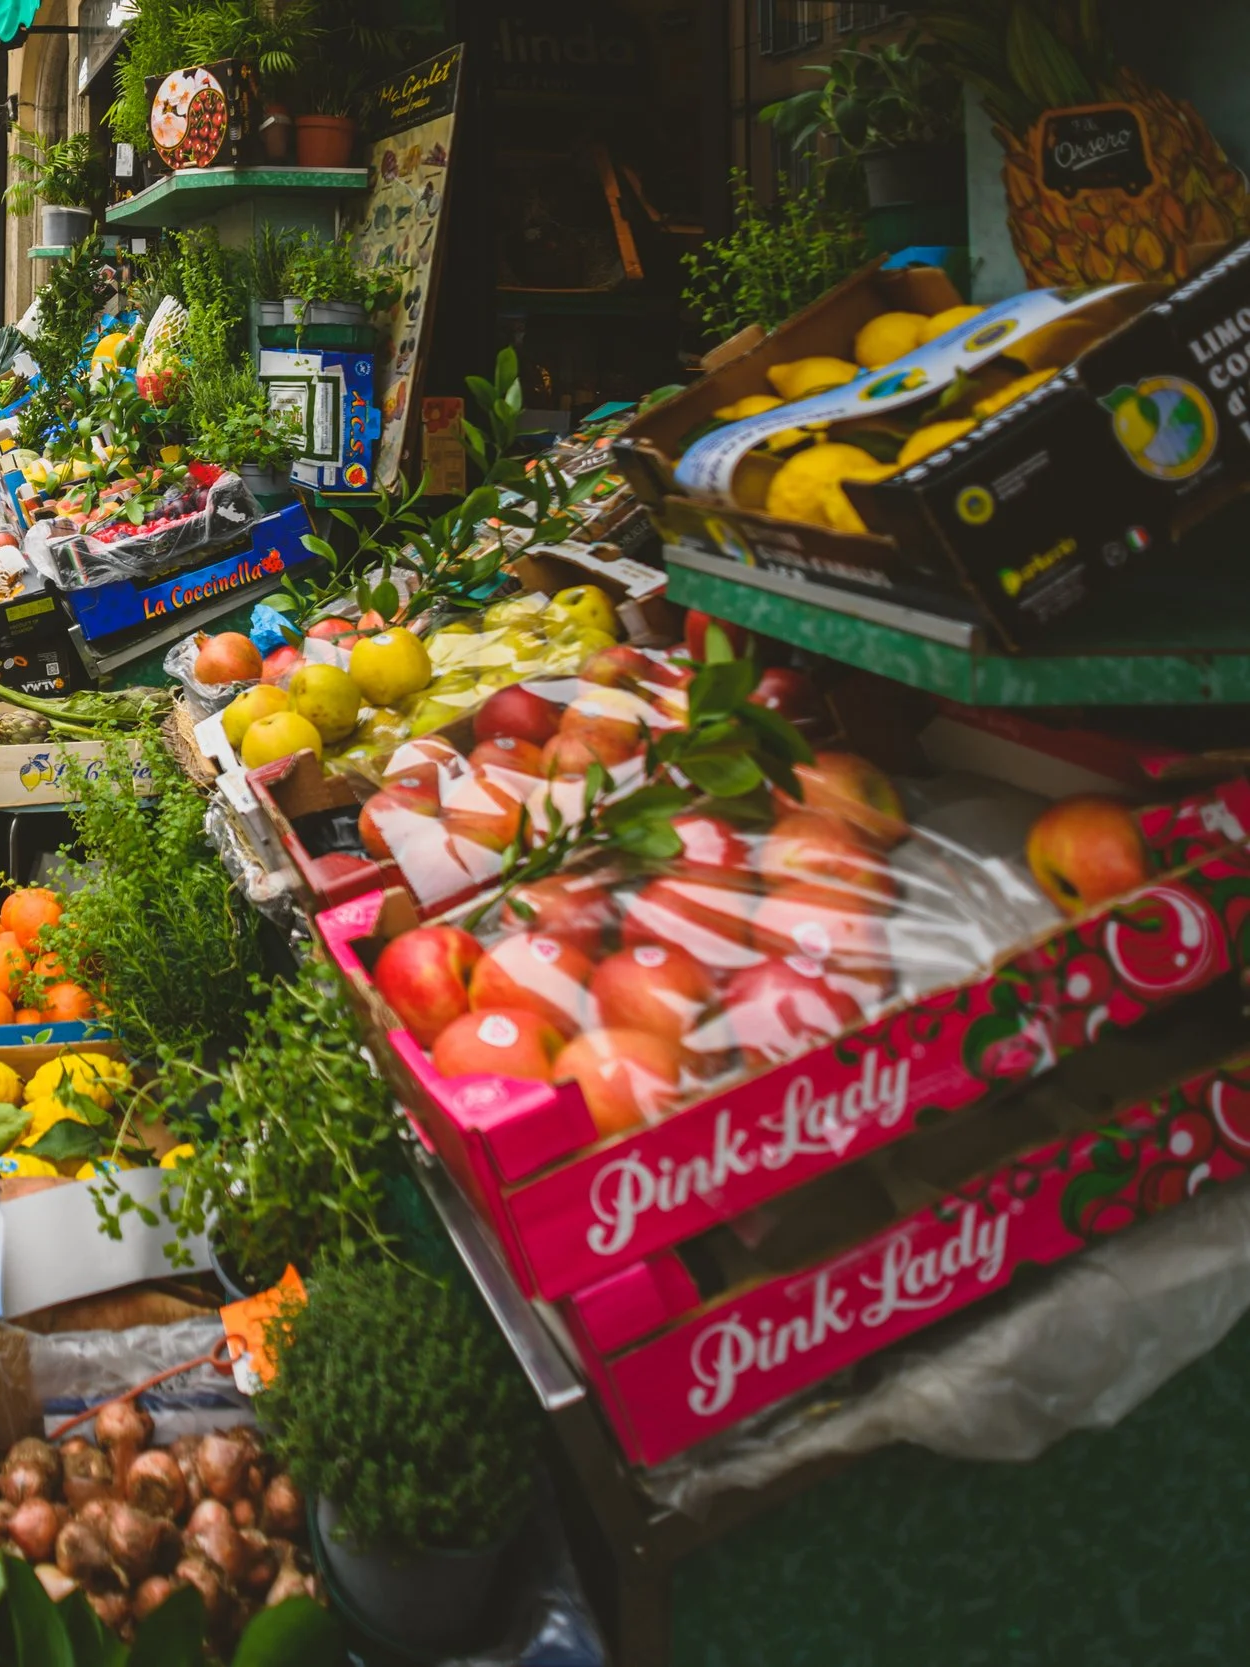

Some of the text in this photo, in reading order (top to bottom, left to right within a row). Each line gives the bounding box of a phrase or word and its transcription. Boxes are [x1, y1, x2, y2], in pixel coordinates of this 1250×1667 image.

[1054, 128, 1132, 168] Orsero
[143, 561, 262, 619] La Coccinella
[586, 1048, 911, 1256] Pink Lady
[687, 1202, 1011, 1417] Pink Lady
